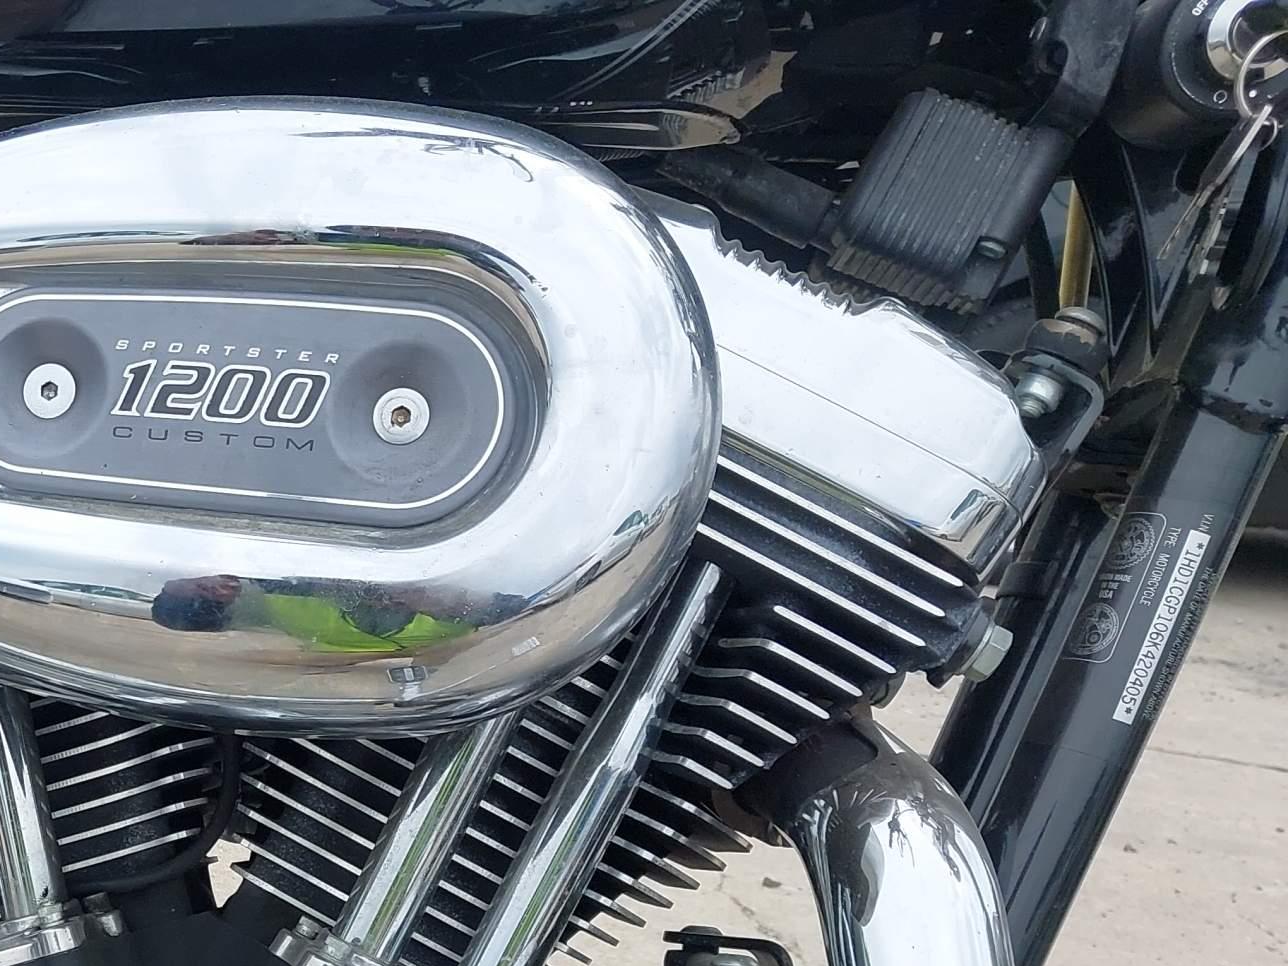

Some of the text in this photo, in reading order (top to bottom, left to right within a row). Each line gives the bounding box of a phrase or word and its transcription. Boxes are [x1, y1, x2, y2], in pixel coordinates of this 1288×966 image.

[115, 339, 340, 364] SPORTSTER
[110, 359, 331, 428] 1200
[112, 426, 315, 452] CUSTOM
[1138, 553, 1171, 607] MOTORCYCLE
